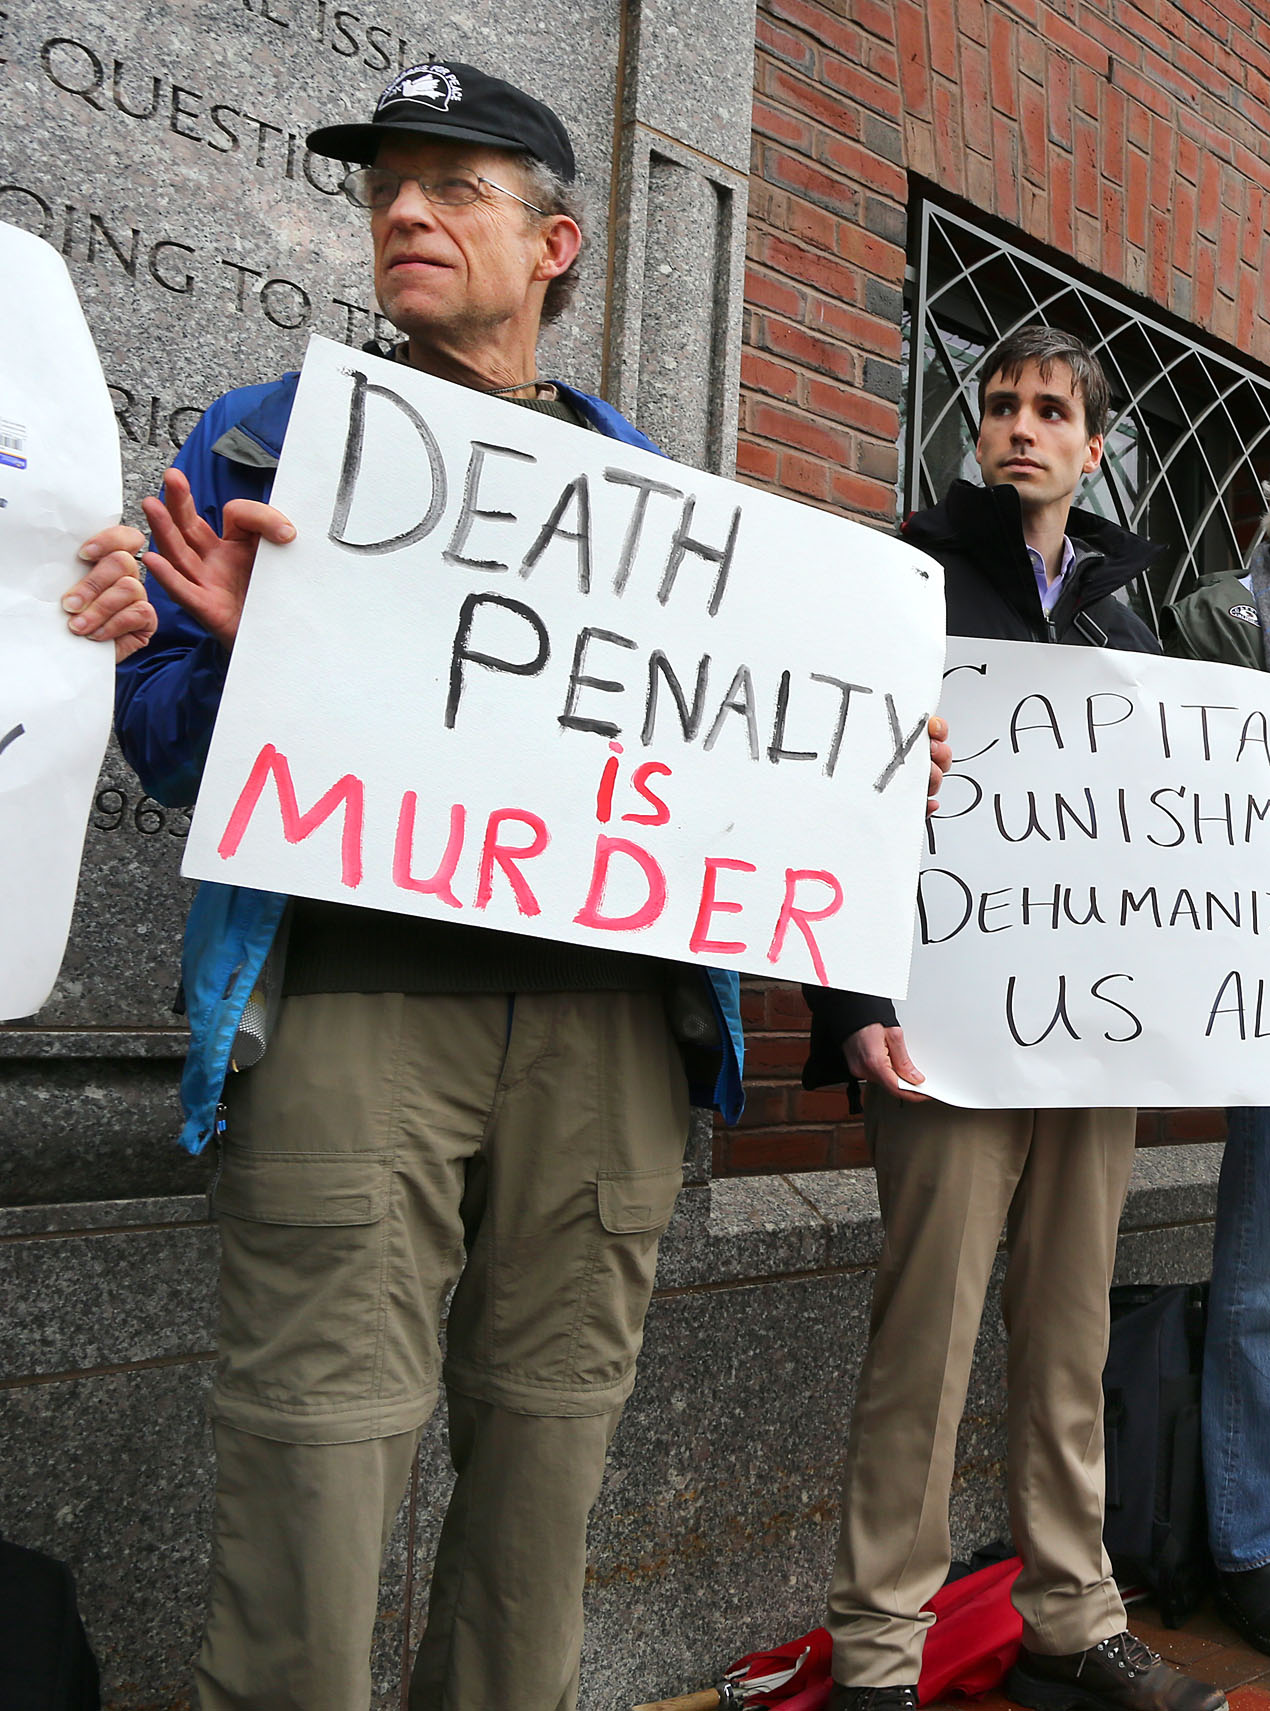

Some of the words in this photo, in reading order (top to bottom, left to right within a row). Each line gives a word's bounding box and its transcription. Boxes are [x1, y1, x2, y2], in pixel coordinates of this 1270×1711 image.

[40, 37, 352, 196] QUESTIO
[445, 73, 463, 102] PEACE
[221, 258, 312, 330] TO
[328, 368, 742, 617] DEATH
[443, 590, 930, 793] PENALTY
[216, 742, 845, 986] MURDER
[1005, 974, 1143, 1047] US
